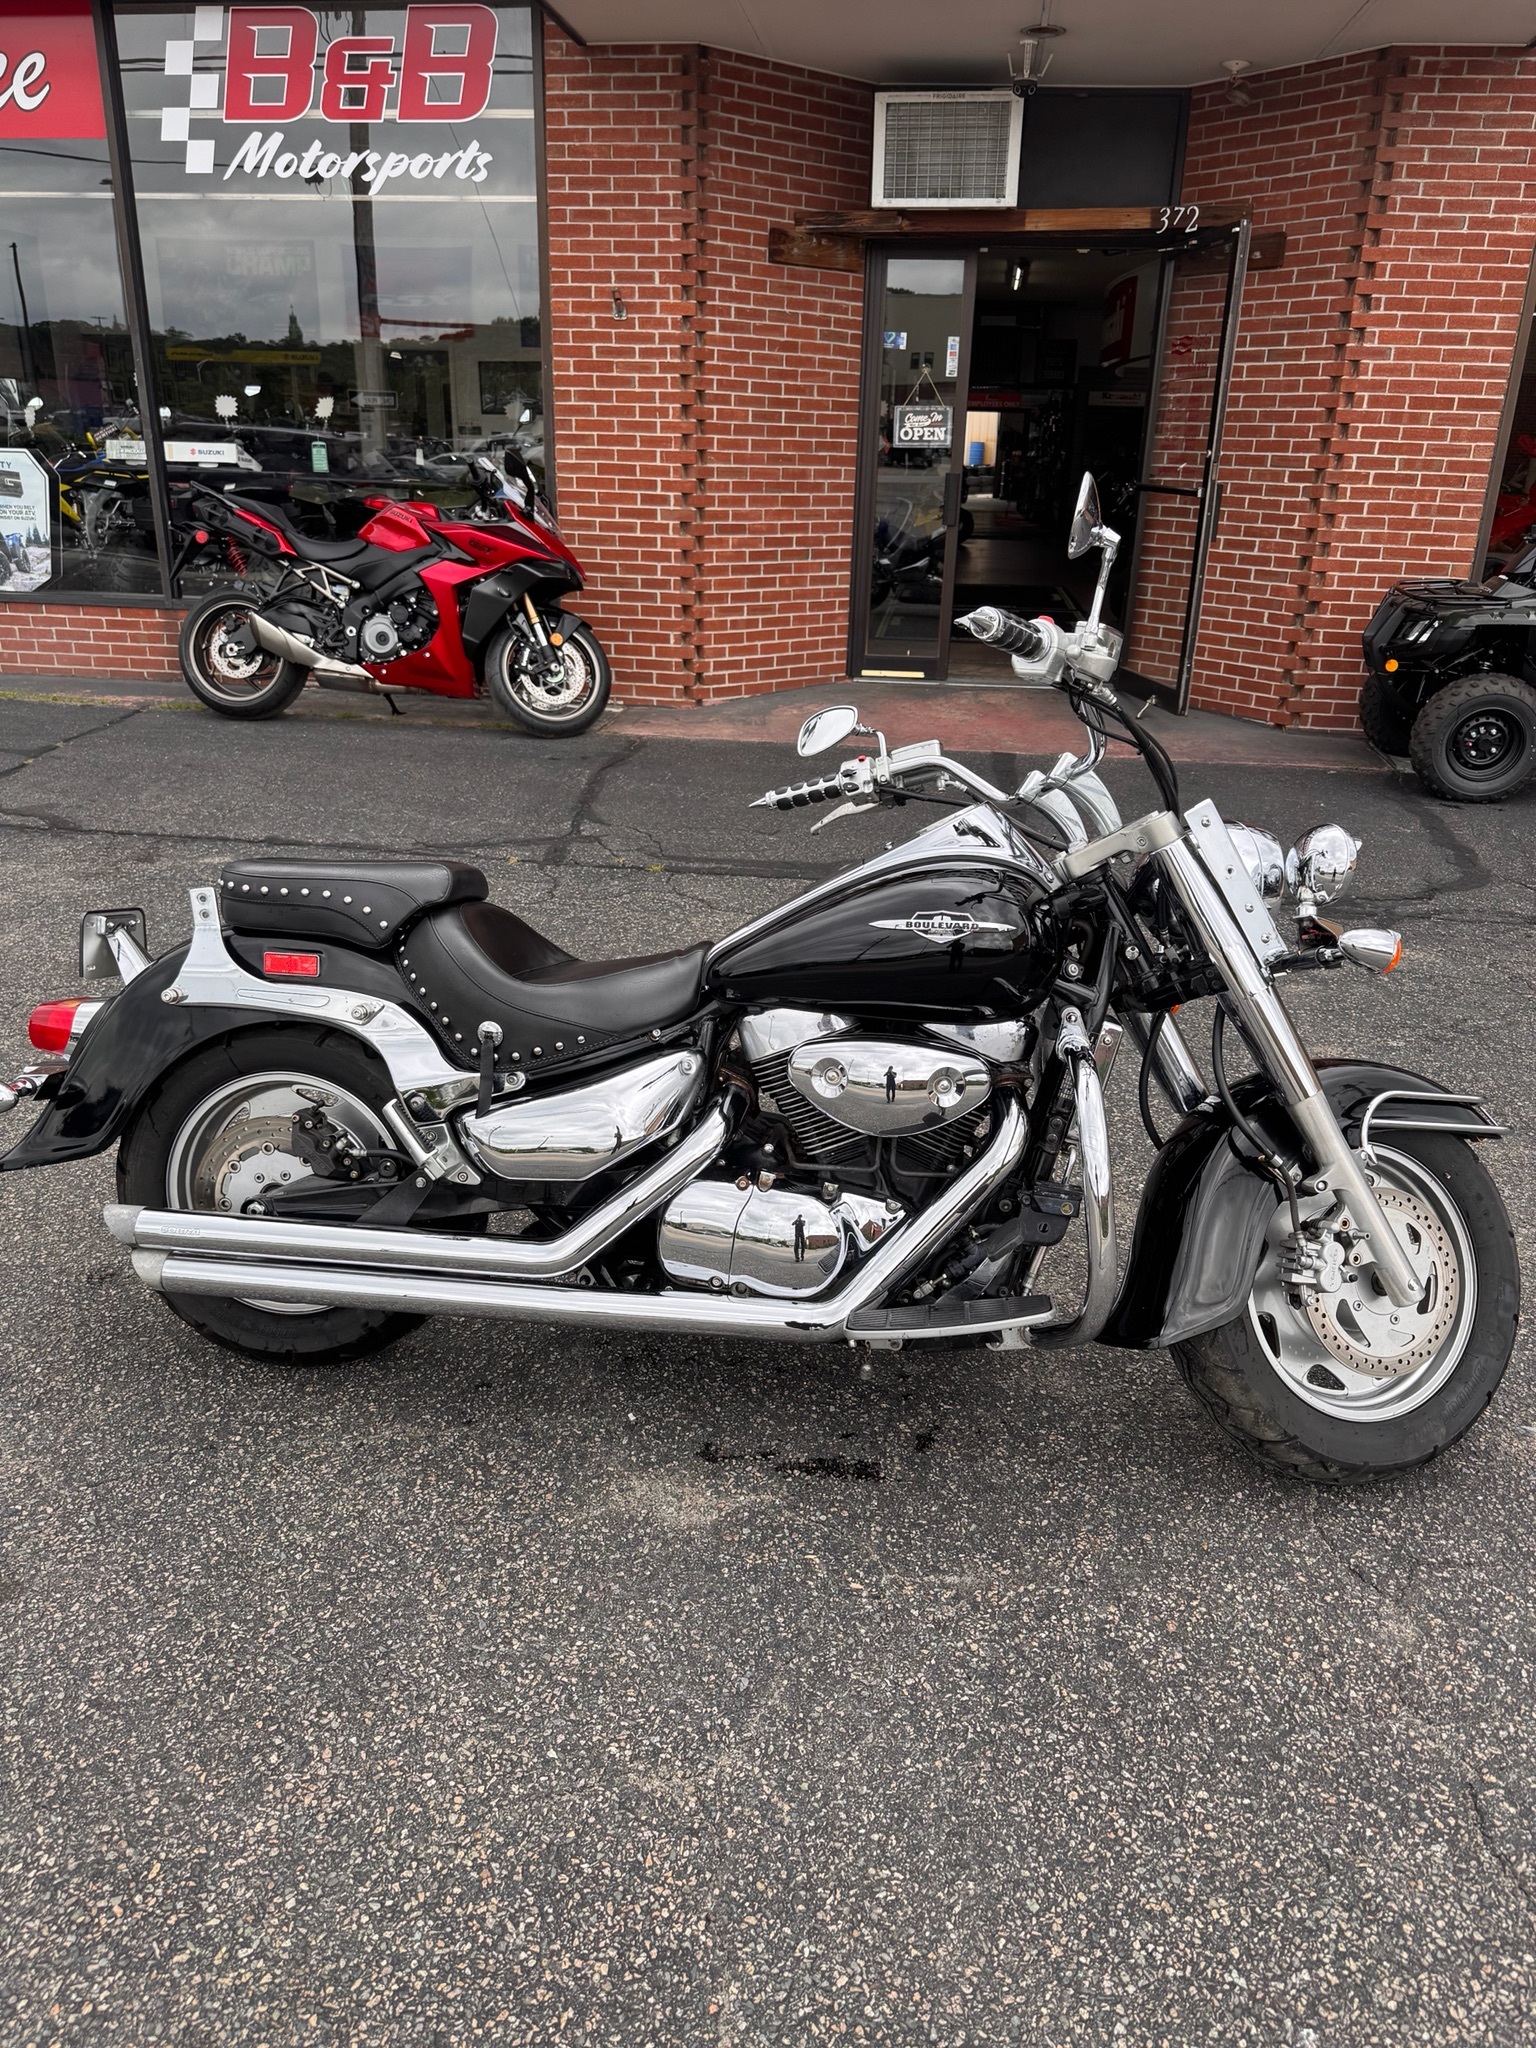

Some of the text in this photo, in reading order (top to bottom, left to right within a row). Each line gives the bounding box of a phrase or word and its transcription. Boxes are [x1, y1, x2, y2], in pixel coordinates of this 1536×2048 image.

[223, 4, 499, 123] B&B
[223, 131, 494, 196] Motorsports
[1156, 205, 1200, 234] 372
[226, 255, 312, 277] CHAMP
[904, 411, 944, 423] Come In
[900, 427, 947, 440] OPEN
[389, 509, 414, 524] SUZUKI
[905, 921, 980, 931] BOULEVARD
[161, 1225, 201, 1236] COBRA
